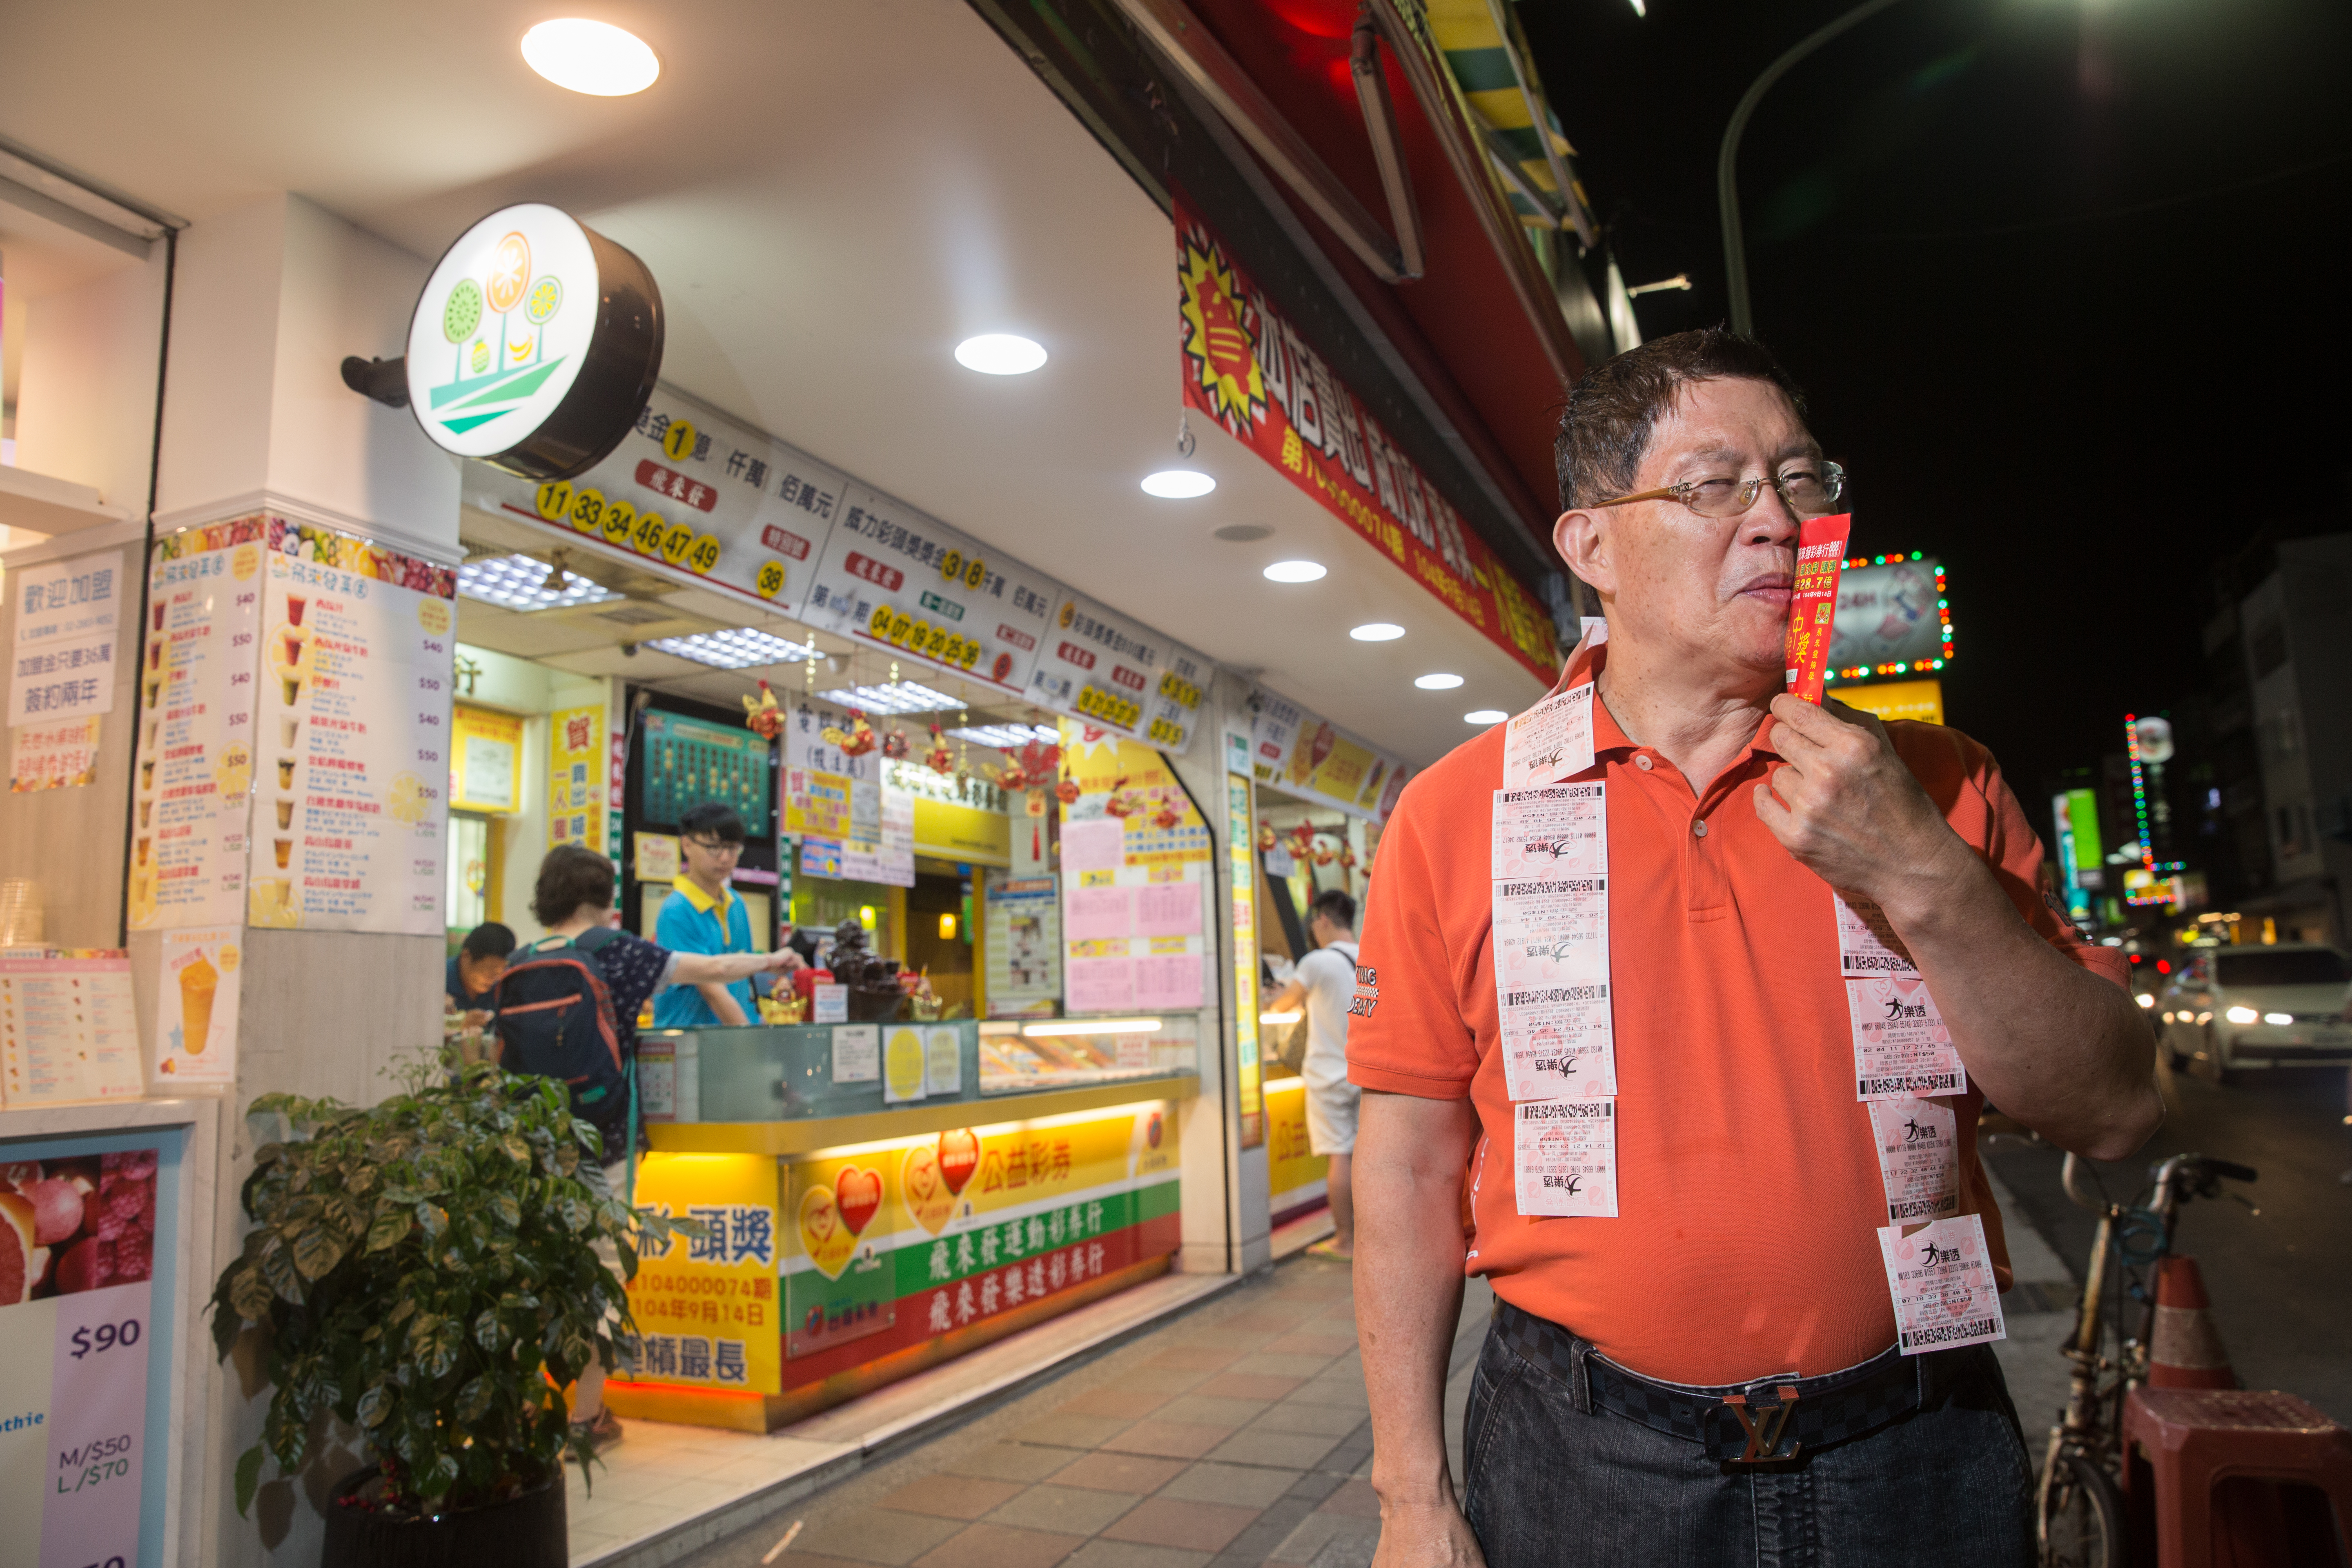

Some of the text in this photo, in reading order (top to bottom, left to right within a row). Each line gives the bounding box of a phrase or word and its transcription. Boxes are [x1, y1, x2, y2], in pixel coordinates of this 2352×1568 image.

[543, 483, 717, 569] 11 33 34 46 47 49
[761, 565, 782, 592] 38
[1820, 559, 1837, 574] 頭獎
[25, 568, 113, 615] 歡迎加盟
[873, 610, 891, 631] 04
[892, 619, 911, 638] 07
[1793, 608, 1811, 664] 中獎
[422, 639, 443, 654] $40
[24, 678, 98, 714] 簽約兩年
[419, 676, 441, 691] $50
[418, 712, 440, 726] $40
[418, 748, 439, 763] $50
[1590, 1045, 1602, 1053] 00183
[981, 1137, 1071, 1196] 公益彩券
[690, 1208, 772, 1263] 頭獎
[930, 1199, 1103, 1281] 飛來發運動彩券行
[634, 1298, 764, 1327] 104年9月14日
[71, 1319, 141, 1359] $90
[58, 1434, 131, 1469] M/$50
